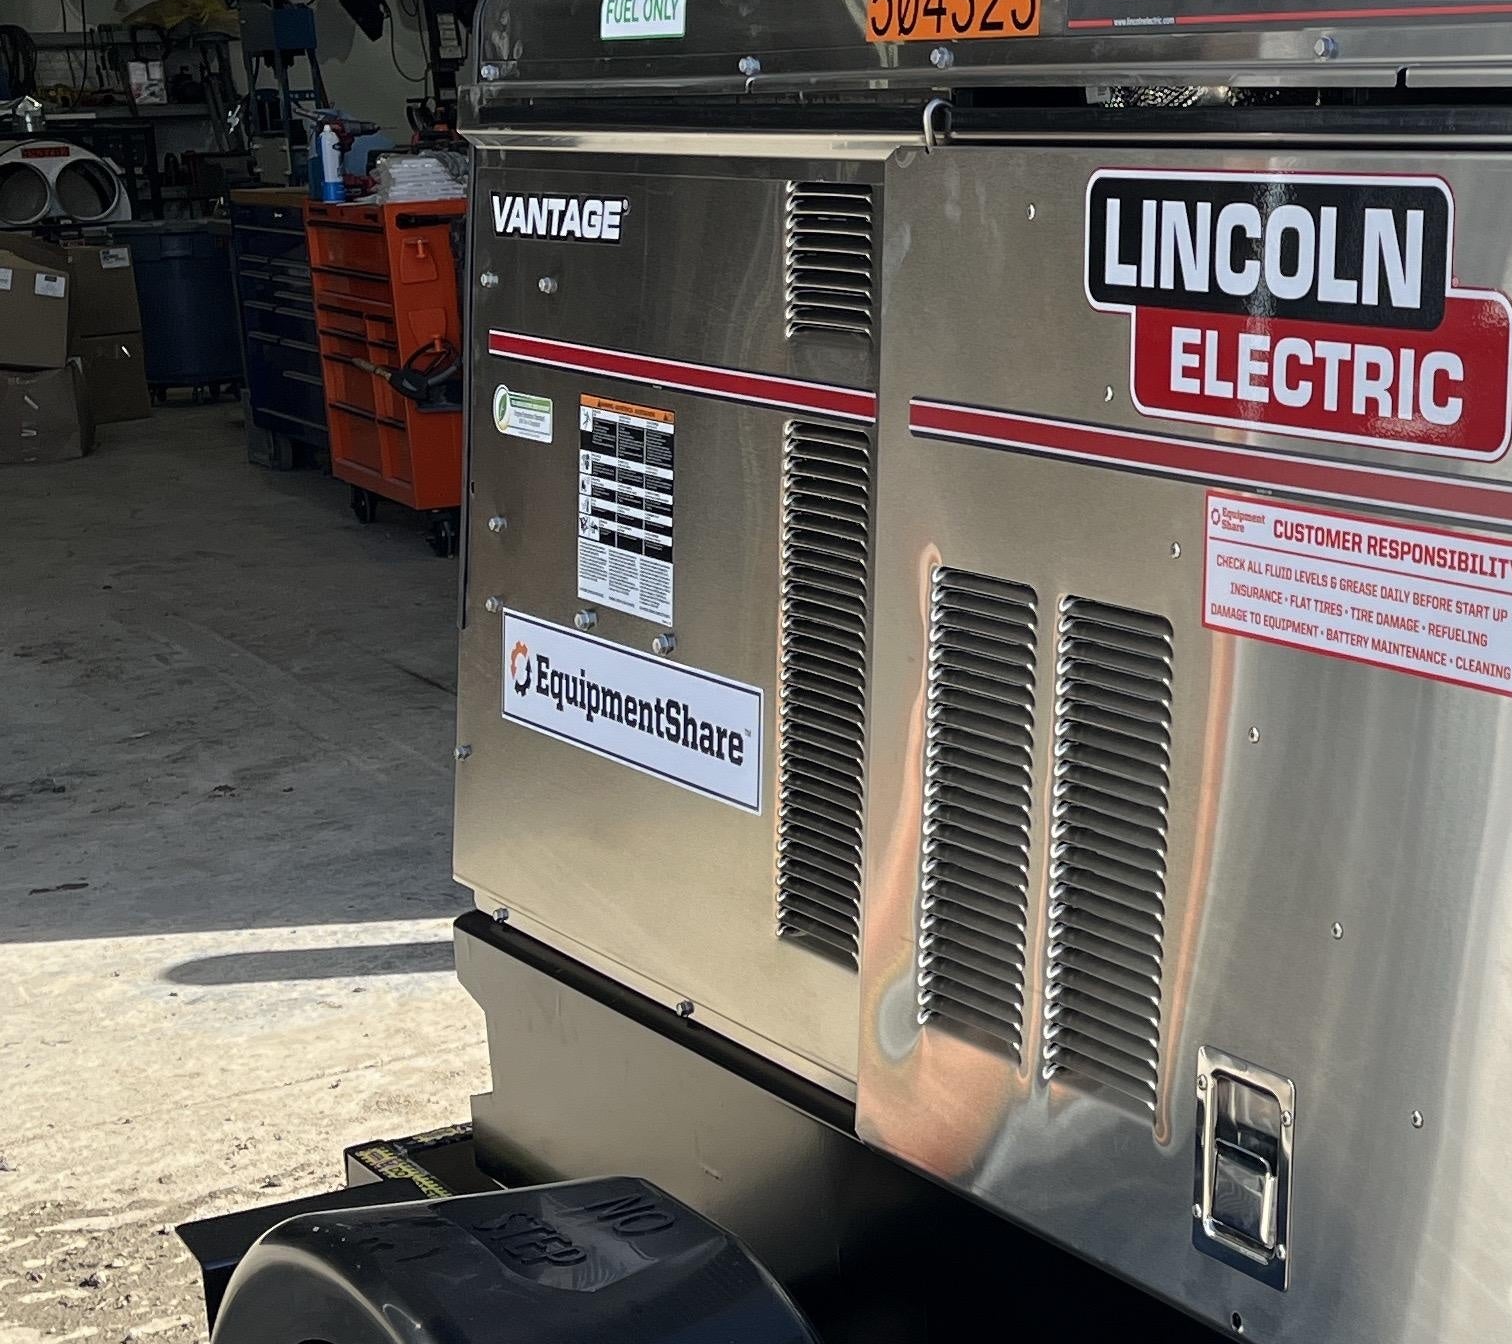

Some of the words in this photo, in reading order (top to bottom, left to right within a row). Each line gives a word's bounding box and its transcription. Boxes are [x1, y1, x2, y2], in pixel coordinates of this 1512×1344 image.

[491, 193, 623, 241] VANTAGE
[1104, 197, 1424, 309] LINCOLN
[1169, 325, 1464, 425] ELECTRIC
[1222, 507, 1265, 524] Equipment
[1222, 519, 1245, 533] Share
[1273, 519, 1362, 553] CUSTOMER
[1216, 554, 1244, 570] CHECK
[1247, 560, 1263, 575] ALL
[1265, 563, 1292, 580] FLUID
[1294, 570, 1328, 588] LEVELS
[1340, 578, 1377, 597] GREASE
[1380, 586, 1410, 603] DAILY
[1413, 592, 1453, 613] BEFORE
[1455, 600, 1490, 619] START
[1492, 608, 1508, 623] UP
[1230, 582, 1282, 605] INSURANCE
[1290, 594, 1311, 609] FLAT
[1313, 599, 1343, 616] TIRES
[1350, 606, 1373, 622] TIRE
[1376, 612, 1420, 633] DAMAGE
[1428, 622, 1488, 647] REFUELING
[1210, 603, 1247, 622] DAMAGE
[1250, 611, 1261, 625] TO
[1263, 614, 1319, 638] EQUIPMENT
[1326, 628, 1369, 649] BATTERY
[1371, 637, 1447, 666] MAINTENANCE
[1455, 656, 1511, 680] CLEANING
[535, 653, 744, 767] EquipmentShare
